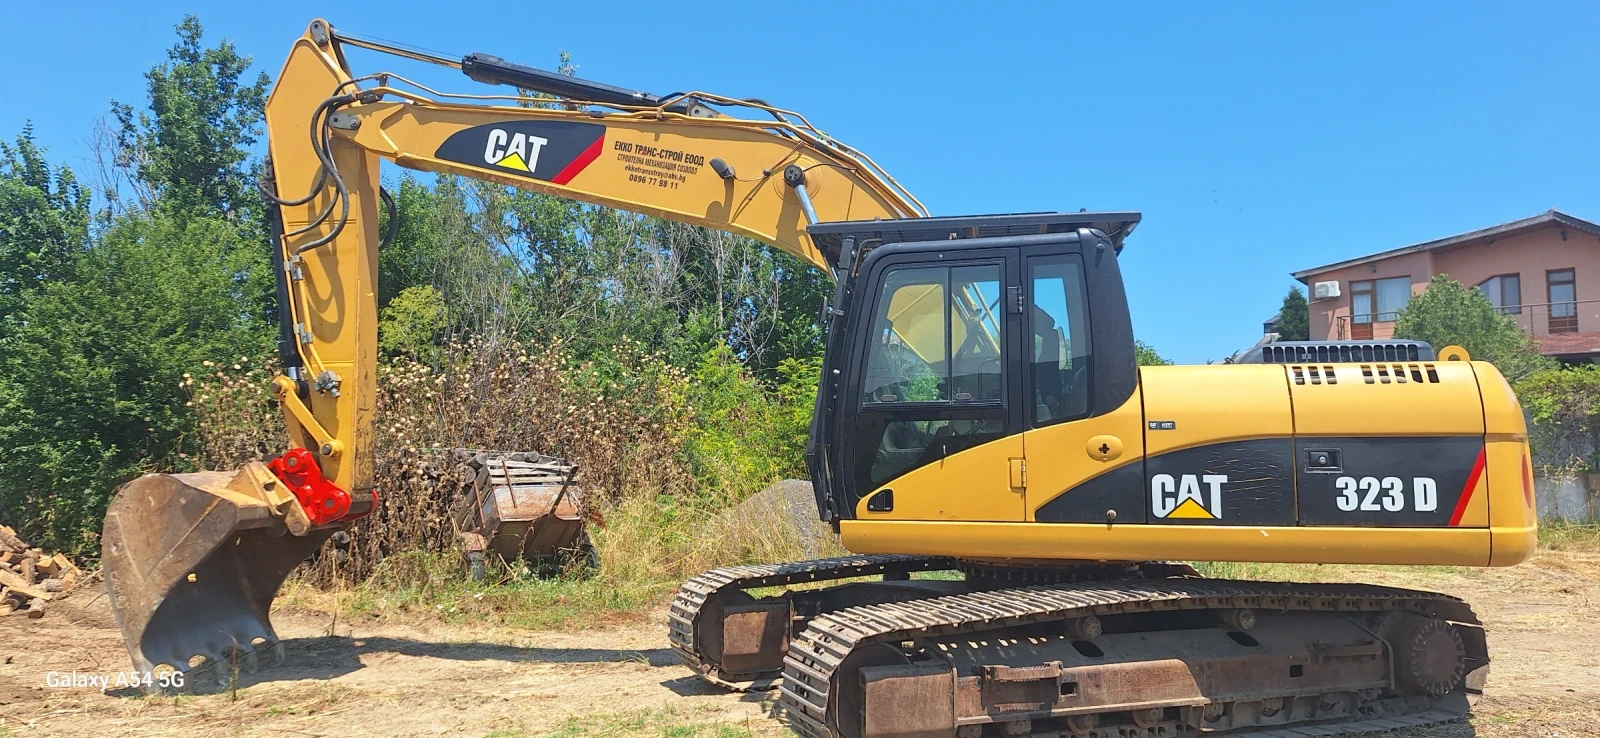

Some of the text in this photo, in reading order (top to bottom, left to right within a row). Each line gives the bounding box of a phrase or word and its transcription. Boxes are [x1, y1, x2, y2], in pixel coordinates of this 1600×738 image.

[484, 128, 548, 173] CAT
[614, 141, 704, 167] ЕККО ТРАНС-СТРОЙ ЕООД
[628, 174, 679, 189] 0896 77 98 11
[1151, 474, 1228, 519] CAT
[1335, 476, 1438, 512] 323 D
